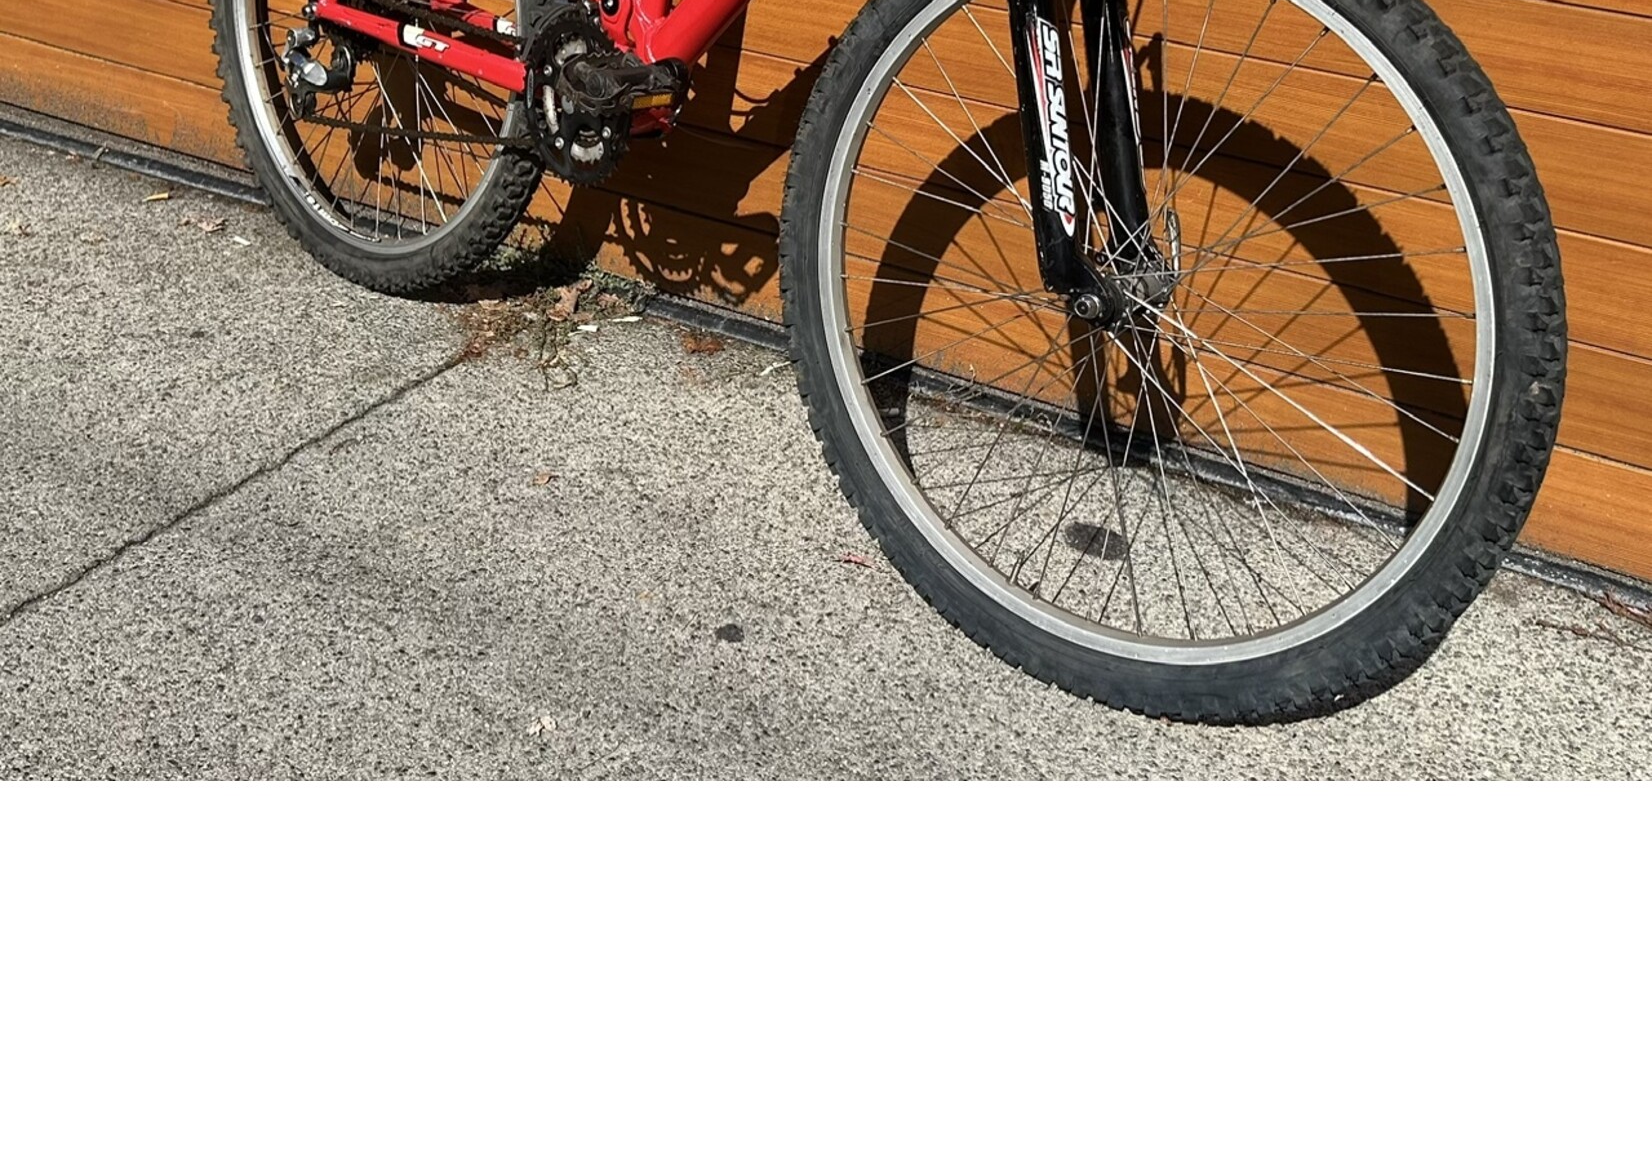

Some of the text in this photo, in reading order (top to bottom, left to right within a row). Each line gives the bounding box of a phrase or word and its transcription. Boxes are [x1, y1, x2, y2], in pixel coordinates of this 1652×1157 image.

[415, 34, 450, 53] GT
[1040, 26, 1076, 215] SR SUNTOUR
